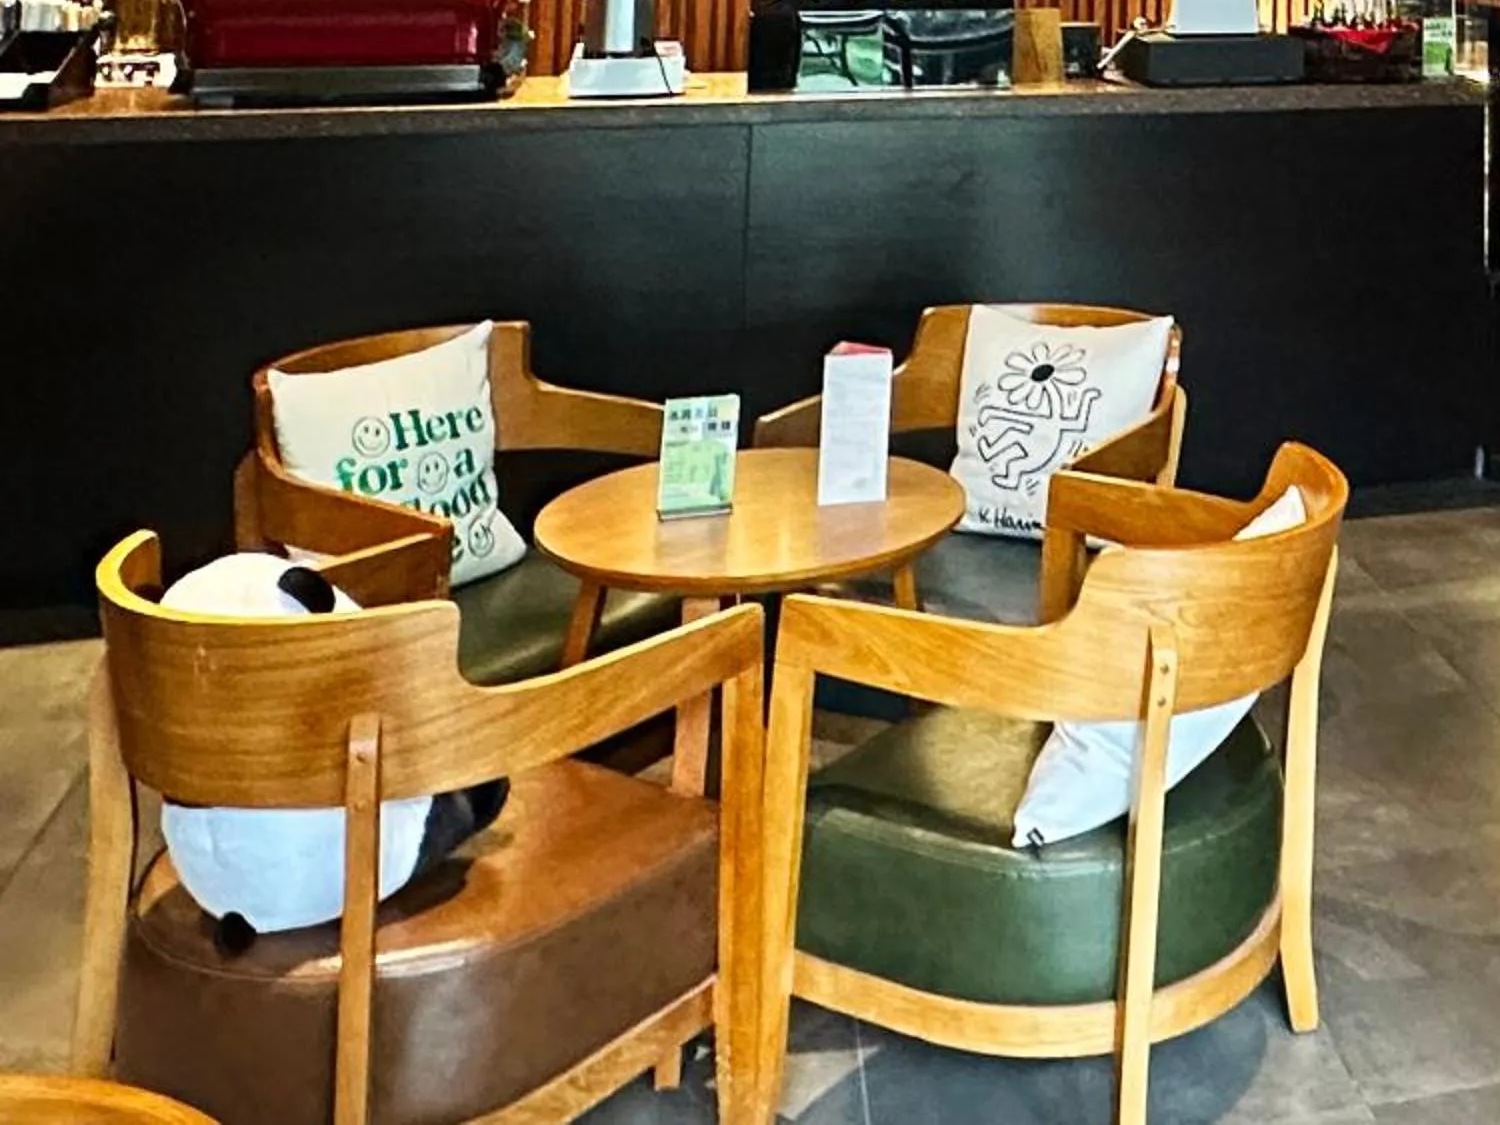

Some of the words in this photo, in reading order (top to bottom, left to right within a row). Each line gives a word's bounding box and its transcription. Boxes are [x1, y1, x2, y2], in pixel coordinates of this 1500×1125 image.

[390, 405, 485, 451] Here
[335, 457, 409, 496] for
[453, 448, 475, 478] a
